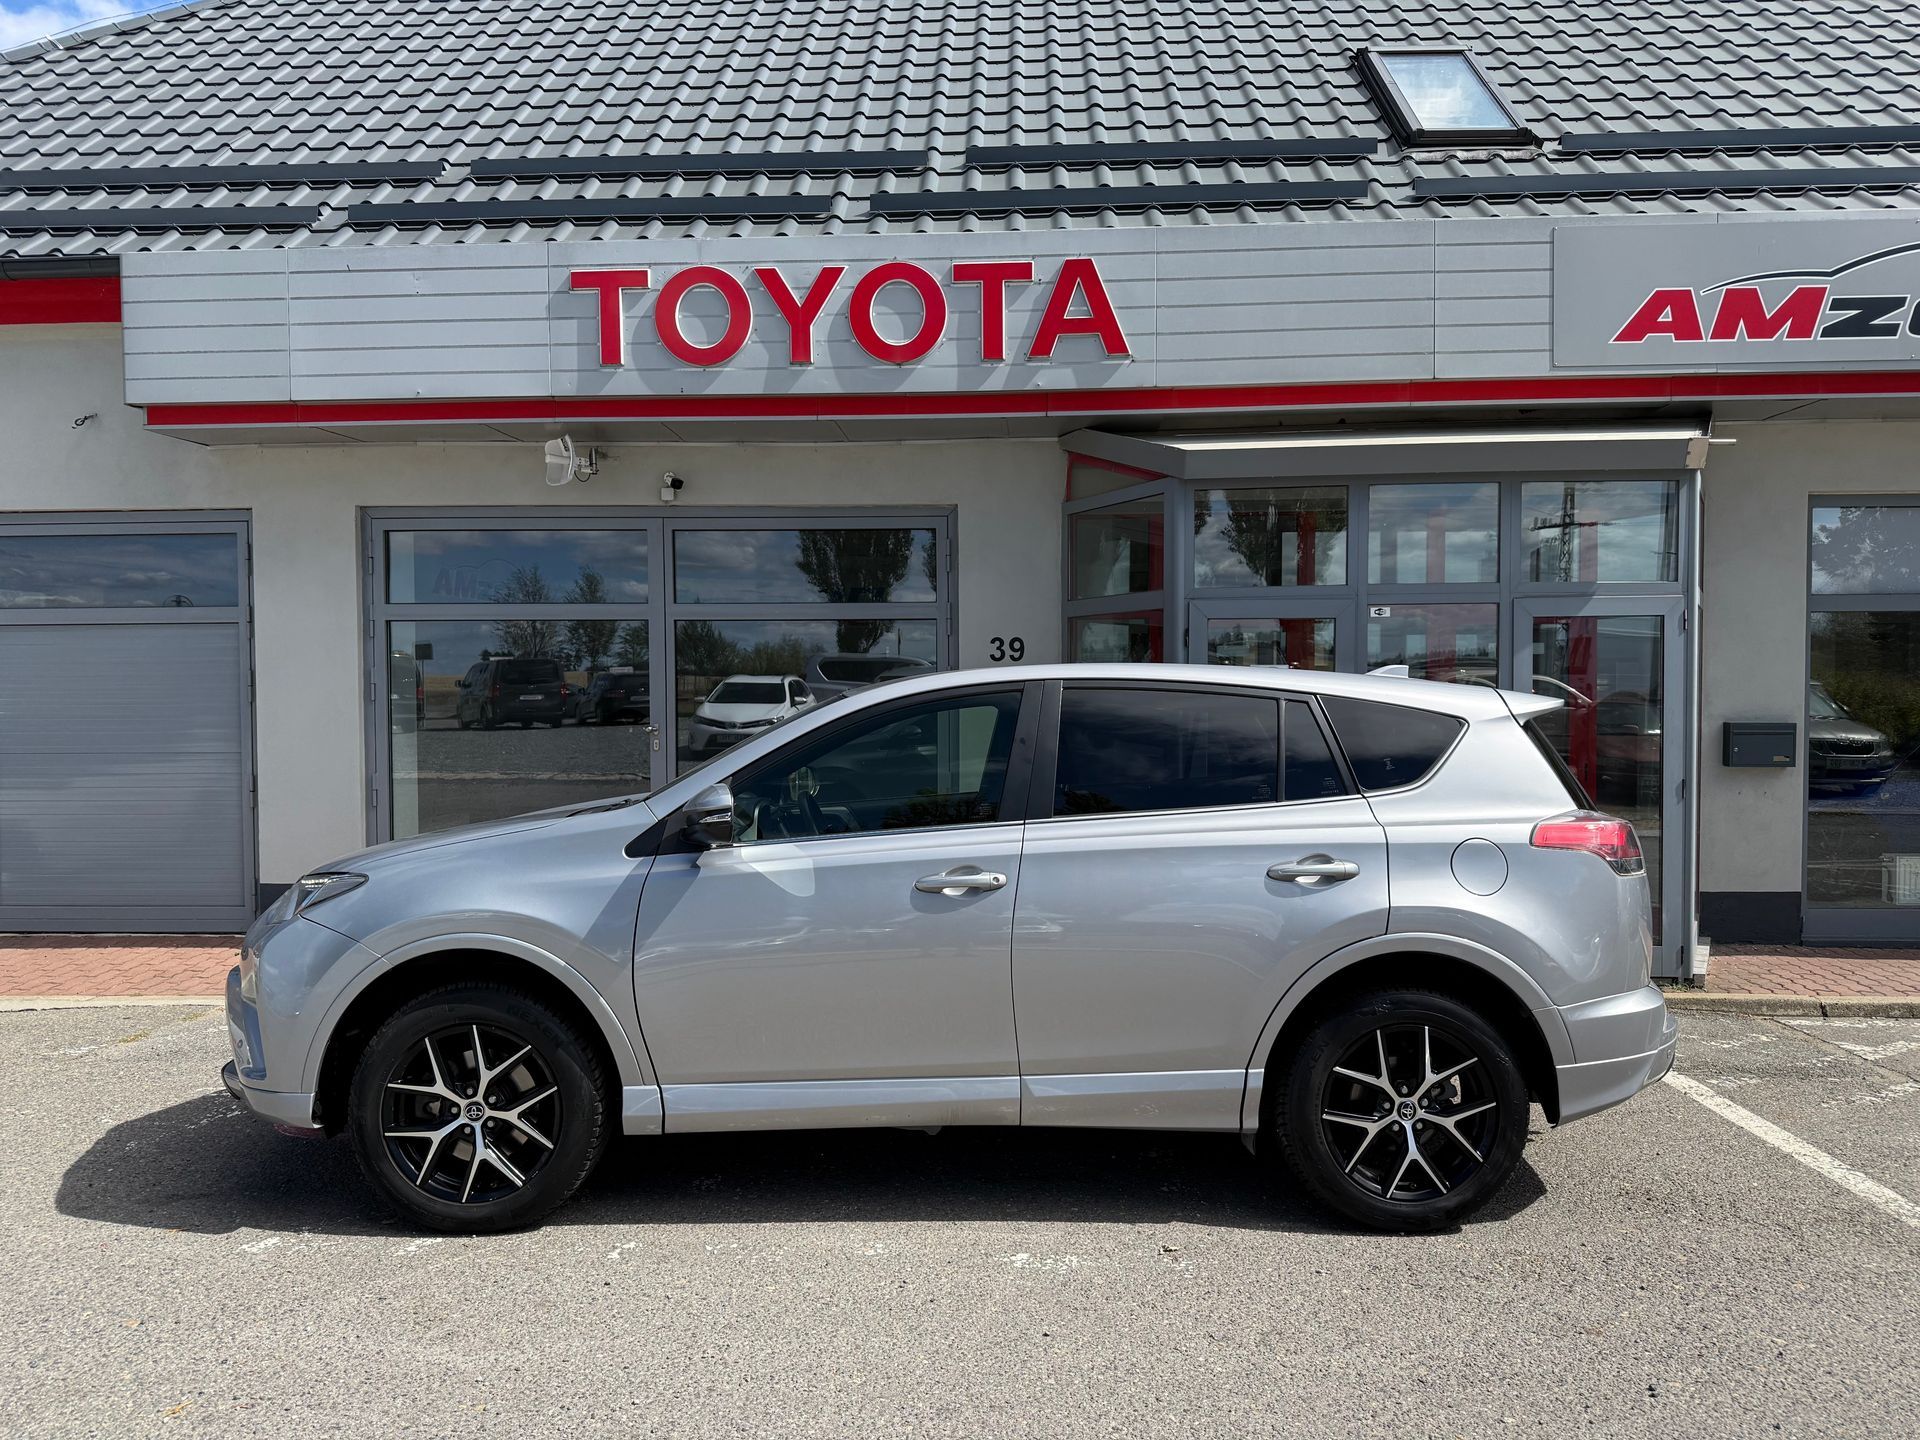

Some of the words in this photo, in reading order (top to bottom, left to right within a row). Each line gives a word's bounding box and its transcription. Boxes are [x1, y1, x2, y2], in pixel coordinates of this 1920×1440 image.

[569, 258, 1133, 368] TOYOTA
[1609, 284, 1920, 344] AMz
[989, 636, 1025, 662] 39
